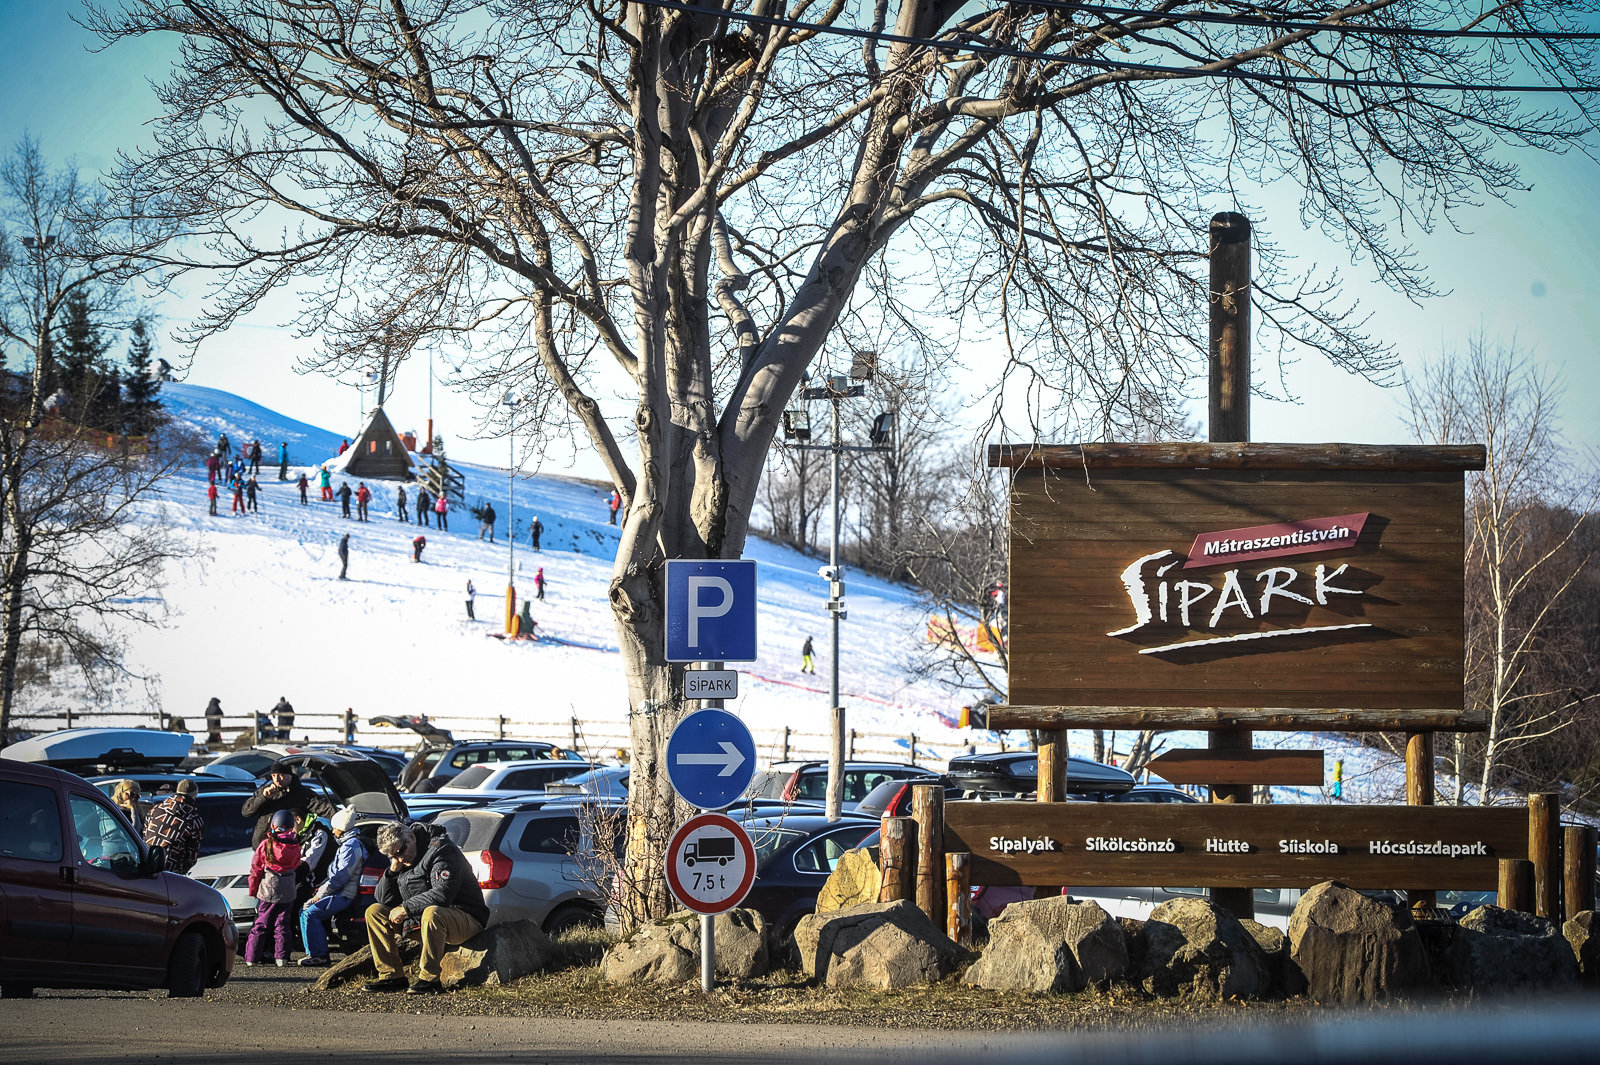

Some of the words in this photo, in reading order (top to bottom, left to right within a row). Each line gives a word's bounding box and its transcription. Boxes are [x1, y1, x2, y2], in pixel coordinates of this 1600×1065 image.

[1203, 525, 1349, 556] Mátraszentistván
[687, 575, 734, 648] P
[1085, 836, 1176, 852] Síkölcsönzó
[1278, 839, 1339, 854] Síiskola
[1369, 840, 1487, 858] Hócsúszdapark
[692, 872, 715, 892] 7,5
[719, 874, 726, 890] t
